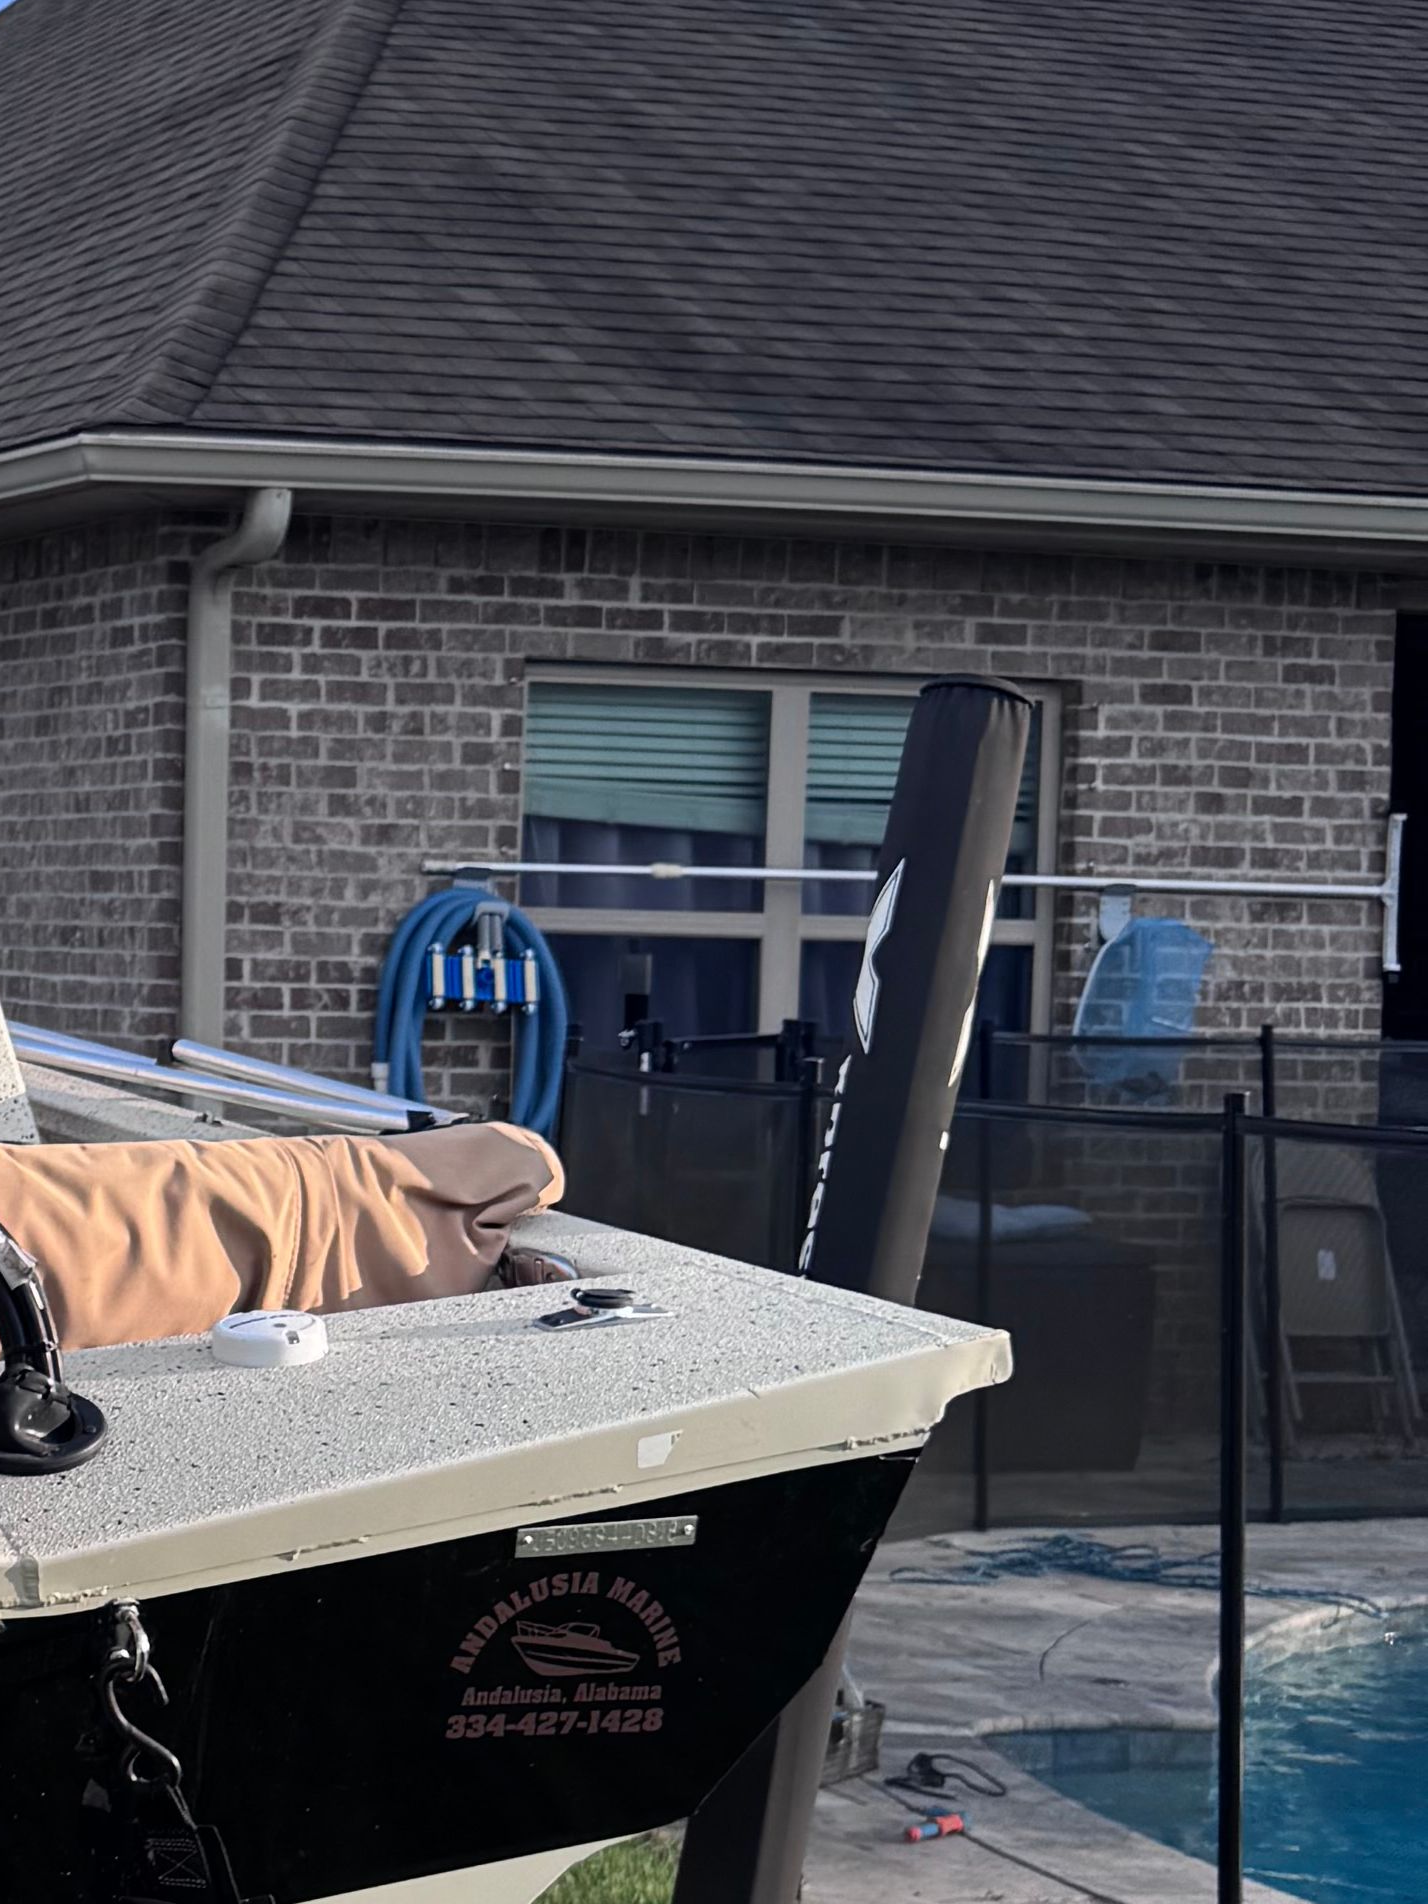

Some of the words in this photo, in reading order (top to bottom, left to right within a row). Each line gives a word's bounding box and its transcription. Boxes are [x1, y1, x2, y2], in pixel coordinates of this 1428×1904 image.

[449, 1571, 600, 1675] ANDALUSIA
[606, 1576, 682, 1668] MARINE
[460, 1684, 568, 1706] Andalusia,
[572, 1682, 663, 1702] Alabama
[444, 1707, 665, 1739] 334-427-1428
